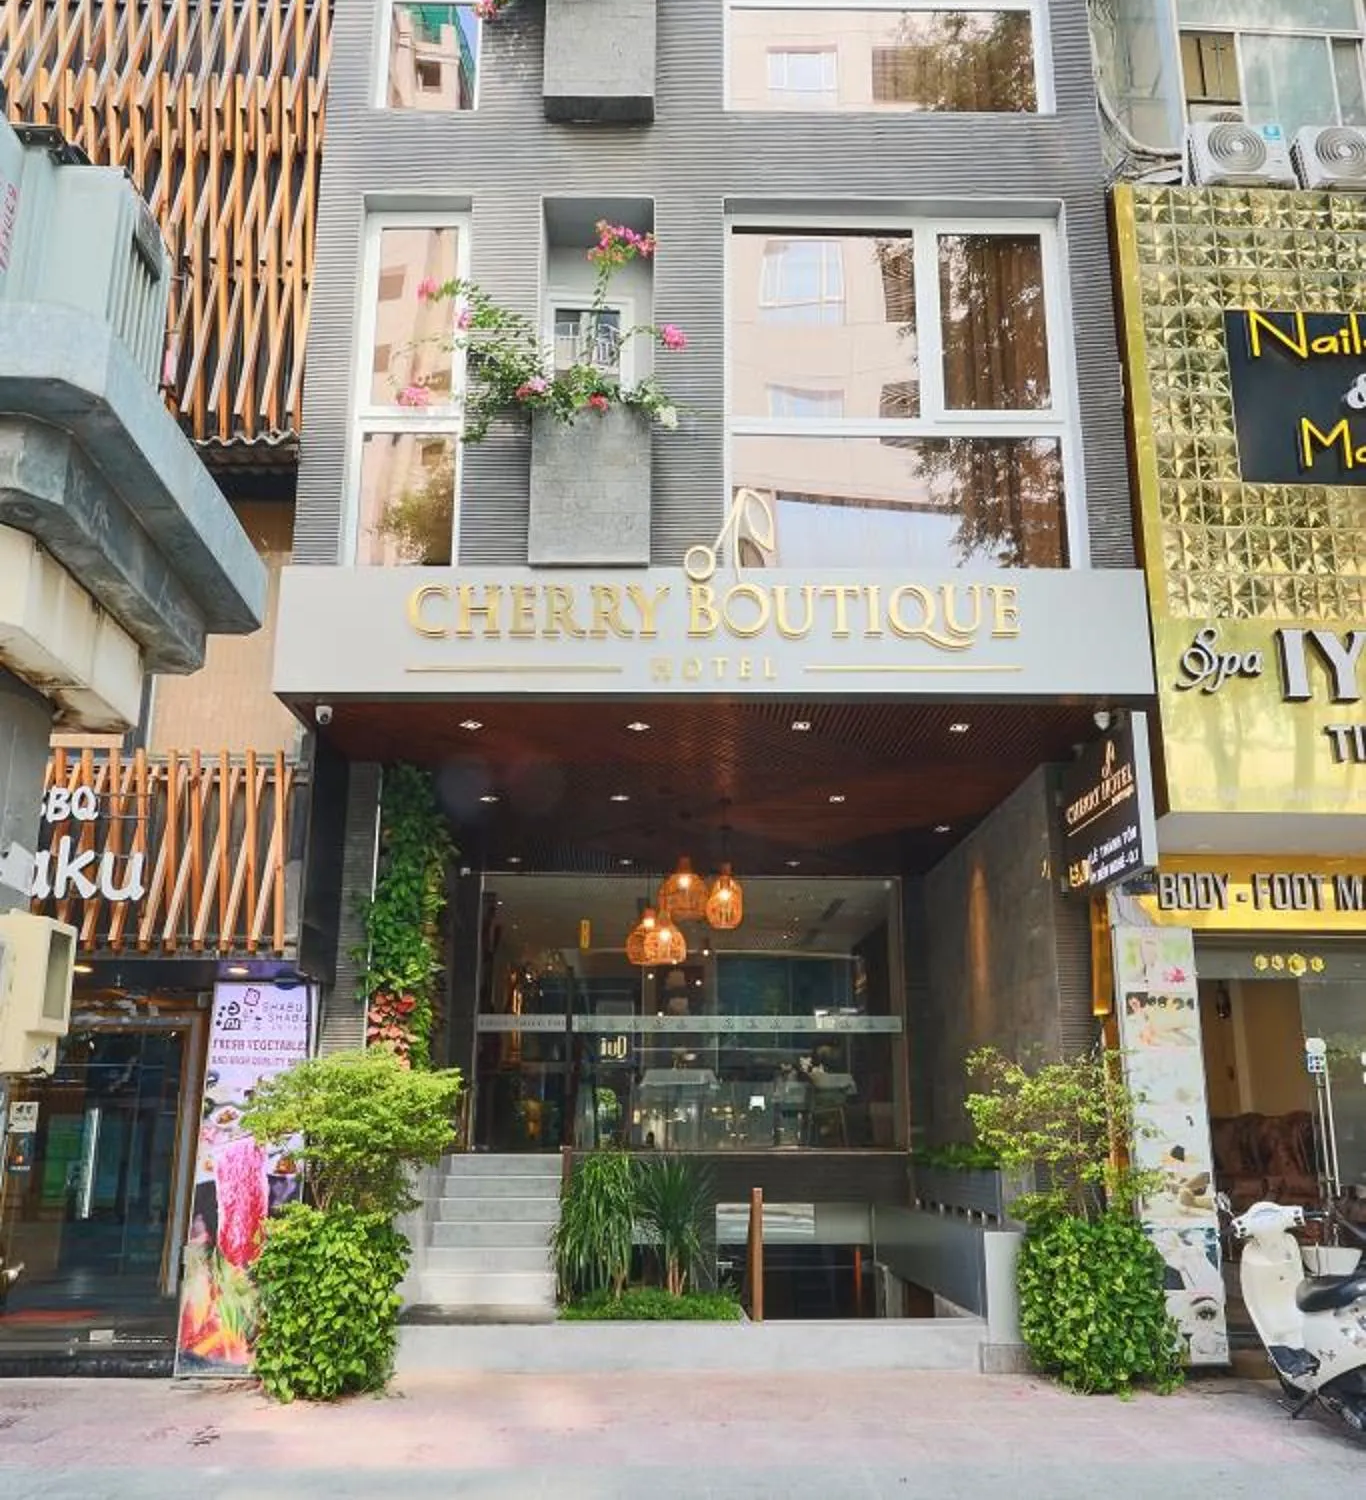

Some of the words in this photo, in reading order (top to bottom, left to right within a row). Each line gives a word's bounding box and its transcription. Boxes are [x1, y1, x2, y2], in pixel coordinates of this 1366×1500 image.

[1248, 310, 1366, 358] Nail
[407, 583, 670, 639] CHERRY
[687, 583, 1022, 651] BOUTIQUE
[651, 656, 778, 681] HOTEL
[1177, 627, 1263, 693] Spa
[1101, 763, 1133, 800] HOTEL
[40, 785, 98, 822] BQ
[1158, 873, 1228, 911] BODY
[1252, 873, 1325, 911] FOOT
